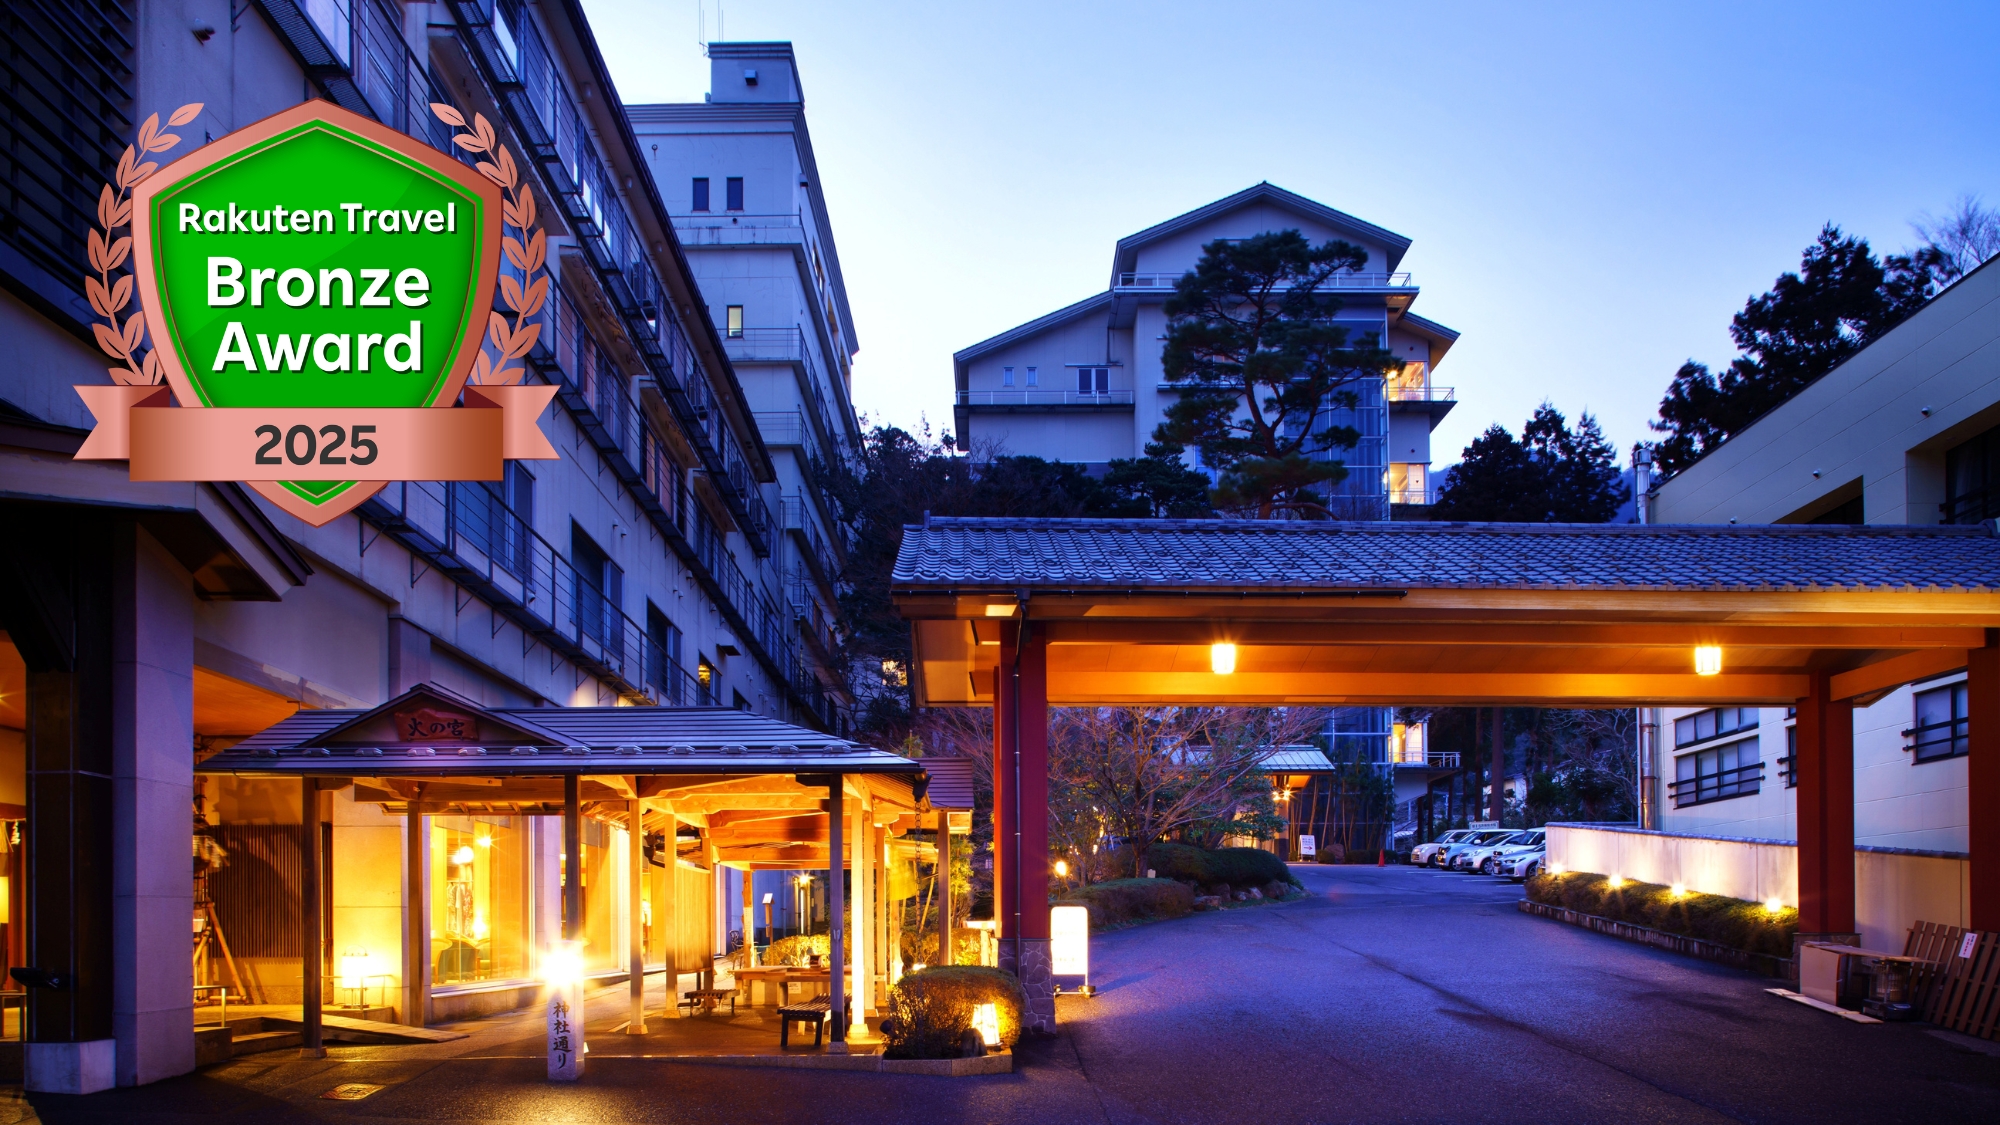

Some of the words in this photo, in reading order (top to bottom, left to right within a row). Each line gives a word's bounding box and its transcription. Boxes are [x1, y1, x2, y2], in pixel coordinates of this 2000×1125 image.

[408, 718, 465, 737] 火の宮
[553, 1001, 572, 1069] 神社通り
